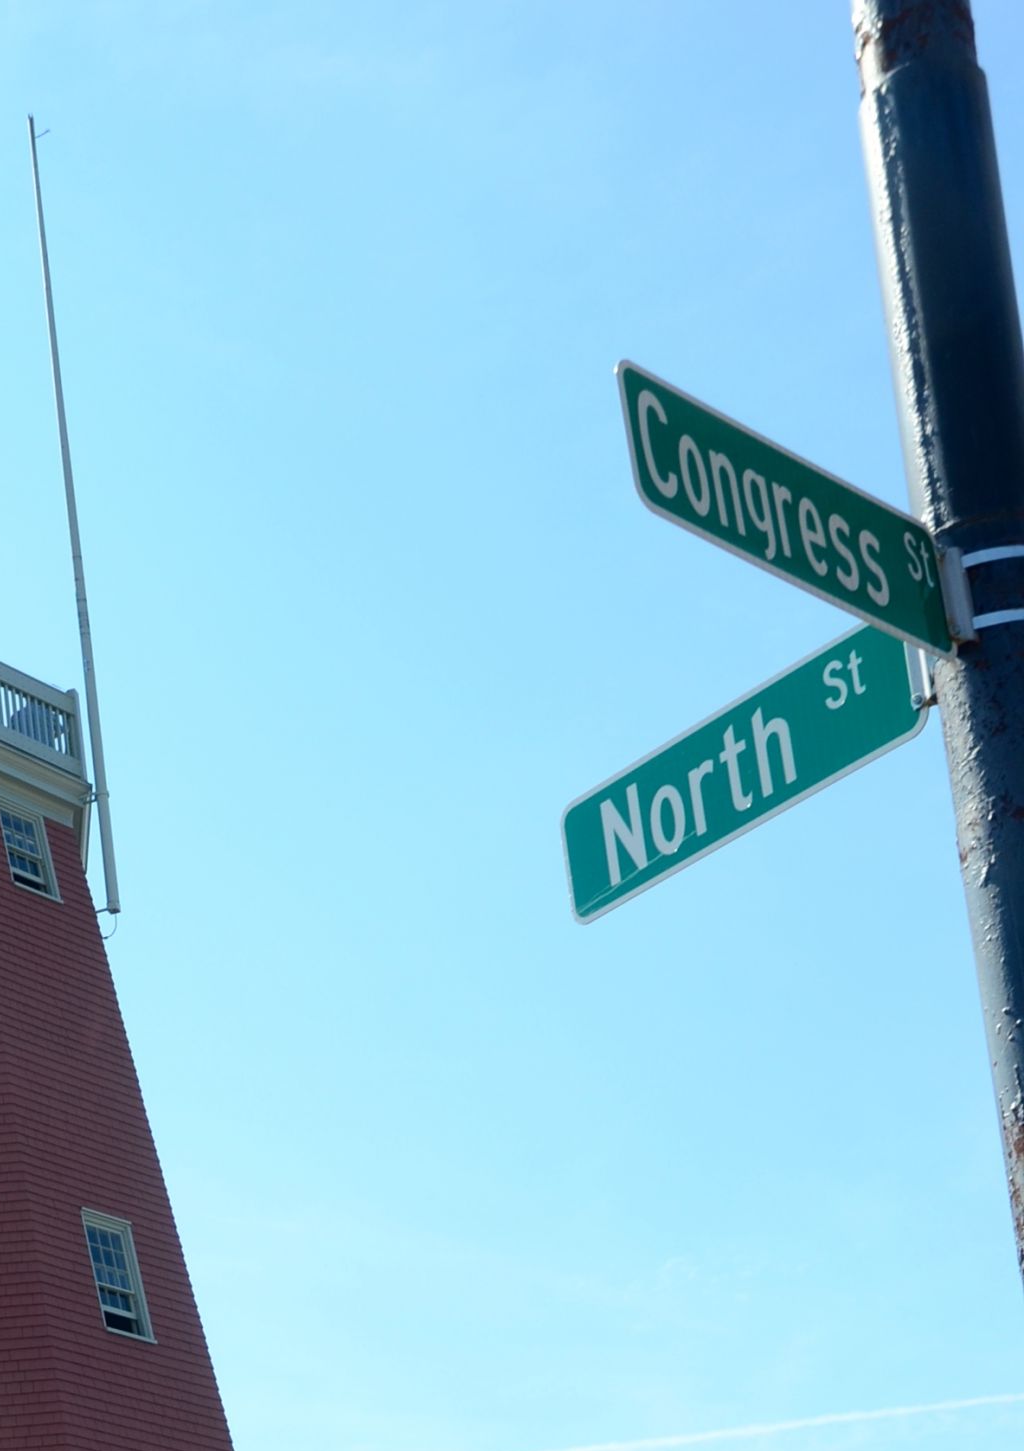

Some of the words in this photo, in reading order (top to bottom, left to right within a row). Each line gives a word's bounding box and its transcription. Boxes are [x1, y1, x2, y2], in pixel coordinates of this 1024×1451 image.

[637, 389, 890, 608] Congress
[903, 531, 935, 589] St
[599, 706, 798, 887] North
[821, 649, 866, 711] St
